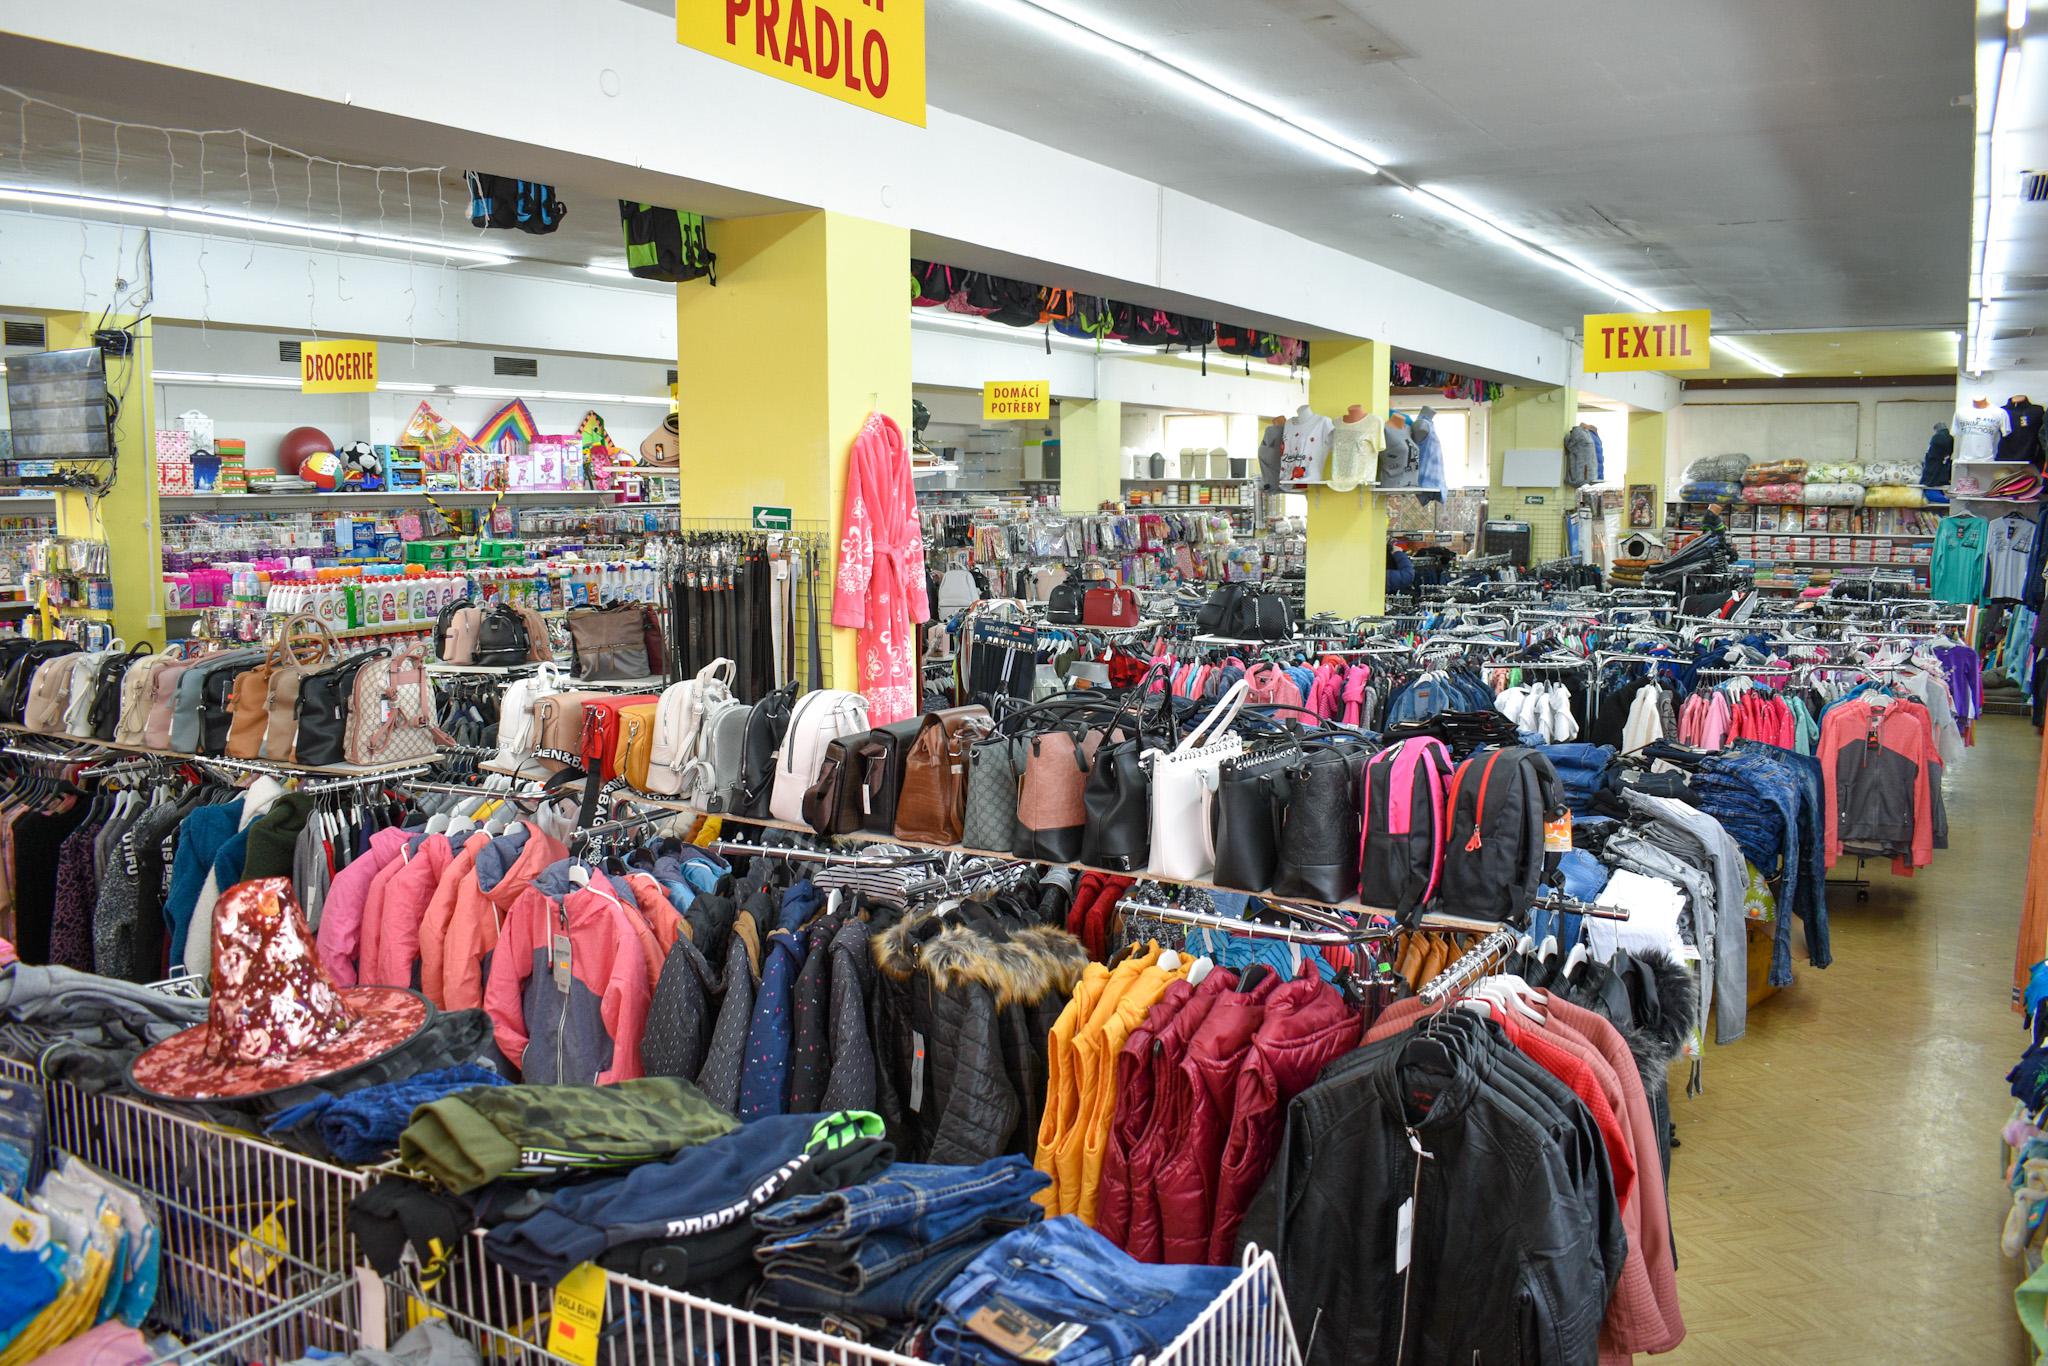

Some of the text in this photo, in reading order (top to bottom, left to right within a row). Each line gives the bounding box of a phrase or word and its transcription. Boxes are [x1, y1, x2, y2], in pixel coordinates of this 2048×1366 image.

[1601, 324, 1692, 359] TEXTIL
[306, 352, 374, 381] DROGERIE
[994, 384, 1039, 398] DOMÁCÍ
[991, 400, 1041, 413] POTŘEBY
